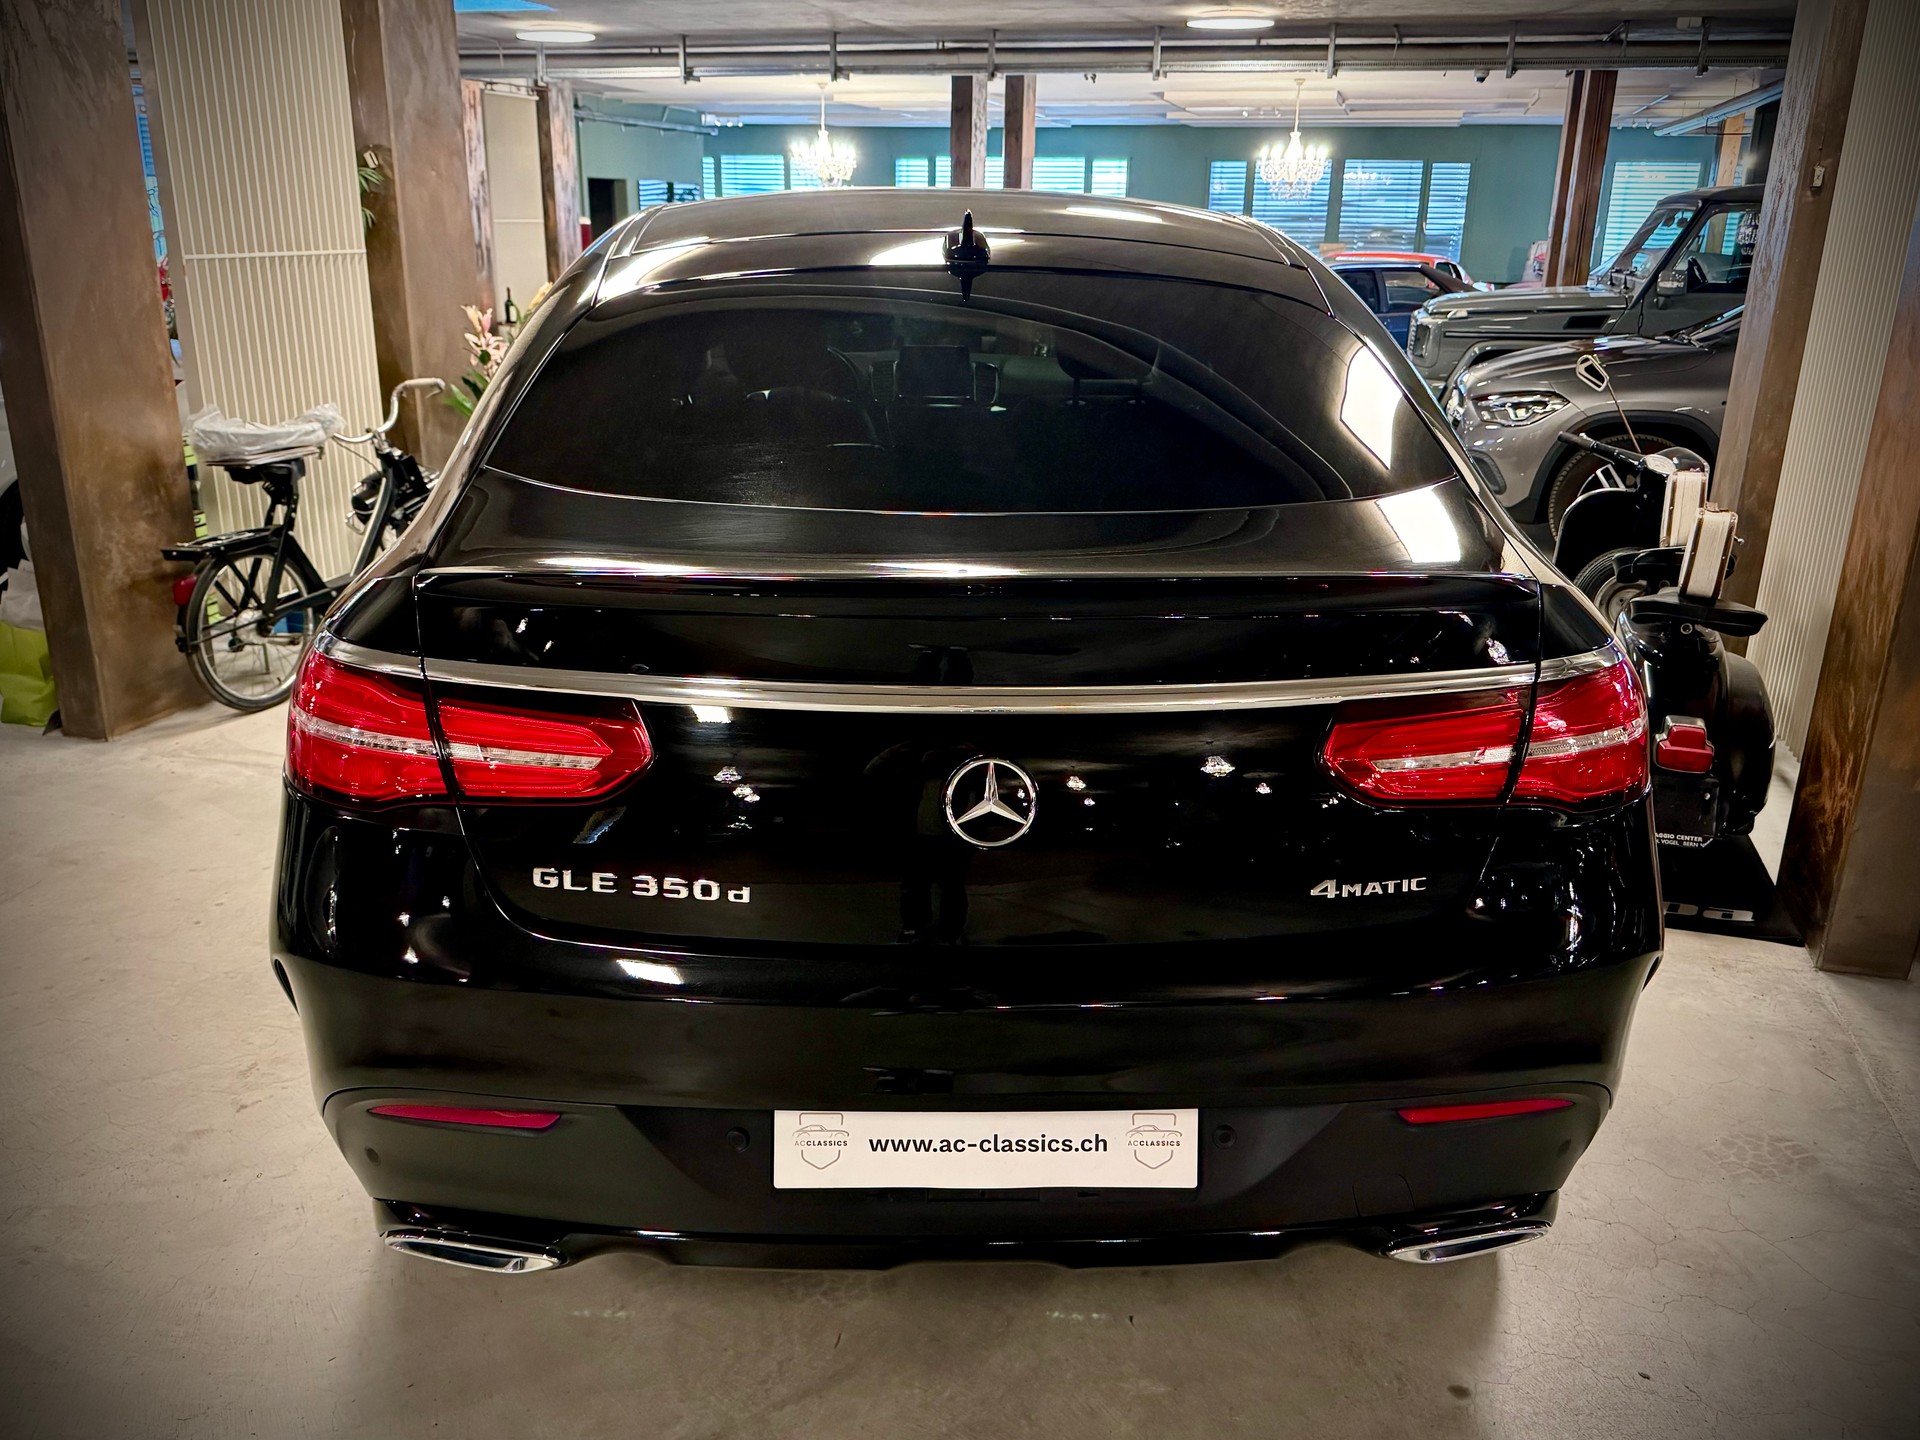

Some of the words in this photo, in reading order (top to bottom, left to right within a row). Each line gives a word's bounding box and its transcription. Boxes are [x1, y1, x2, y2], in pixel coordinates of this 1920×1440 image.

[1676, 834, 1703, 842] CENTER
[532, 867, 618, 894] GLE
[1310, 877, 1427, 899] 4MATIC
[868, 1133, 1109, 1153] www.ac-classics.ch
